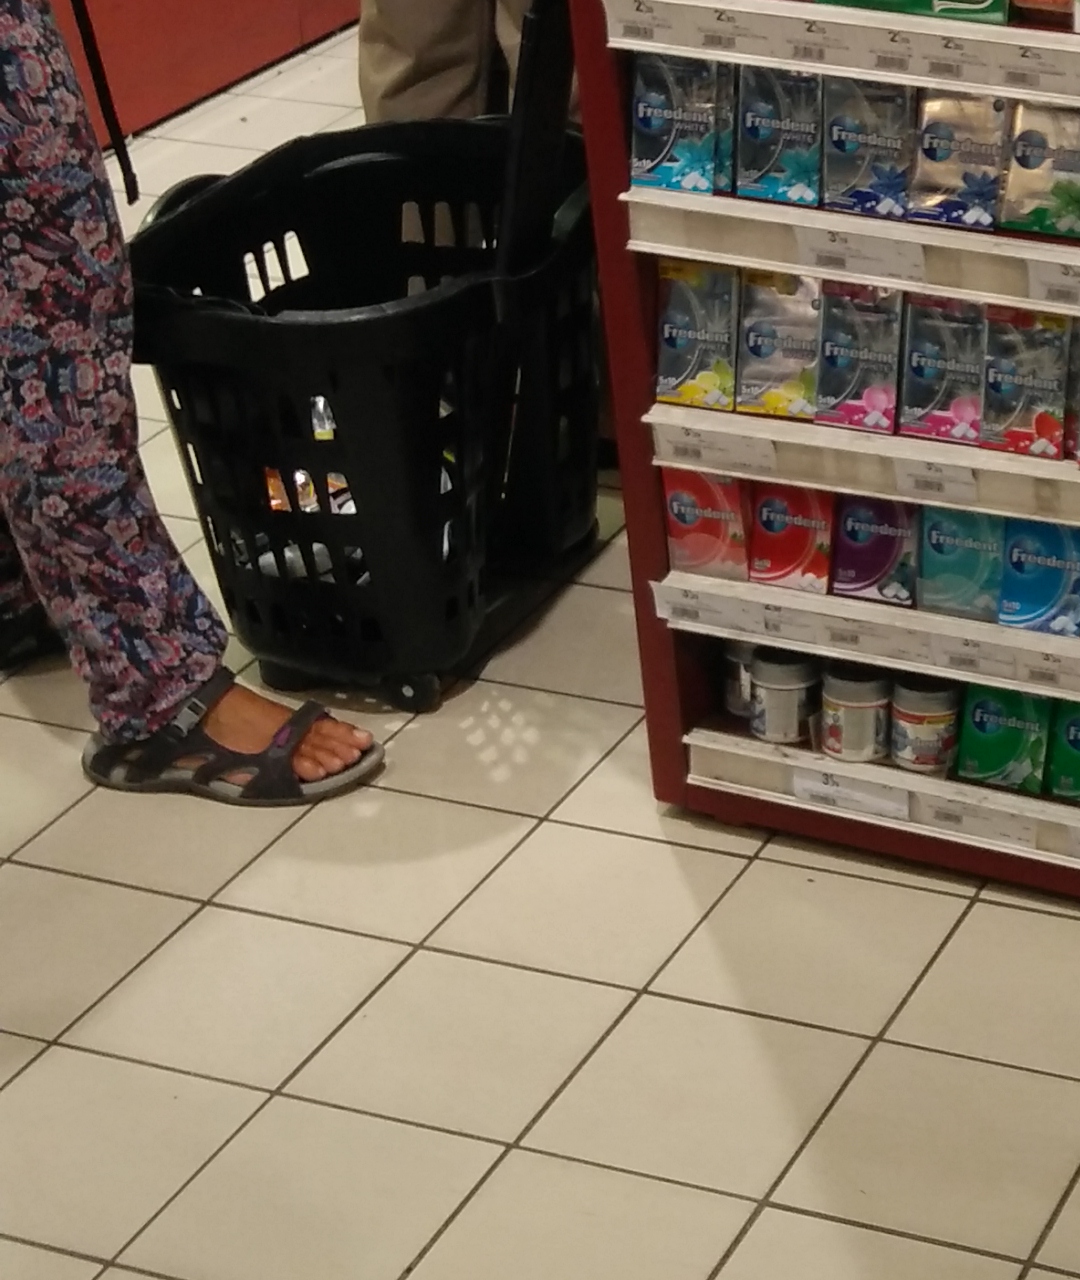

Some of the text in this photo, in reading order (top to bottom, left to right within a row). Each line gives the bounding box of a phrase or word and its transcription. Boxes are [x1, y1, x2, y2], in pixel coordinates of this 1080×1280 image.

[746, 112, 817, 133] Freedent
[832, 125, 903, 150] Freedent
[664, 324, 730, 344] Freedent
[825, 342, 896, 363] Freedent
[911, 352, 980, 374] Freedent
[989, 369, 1060, 391] Freedent
[932, 530, 998, 553] Freedent
[974, 708, 1041, 733] Freedent
